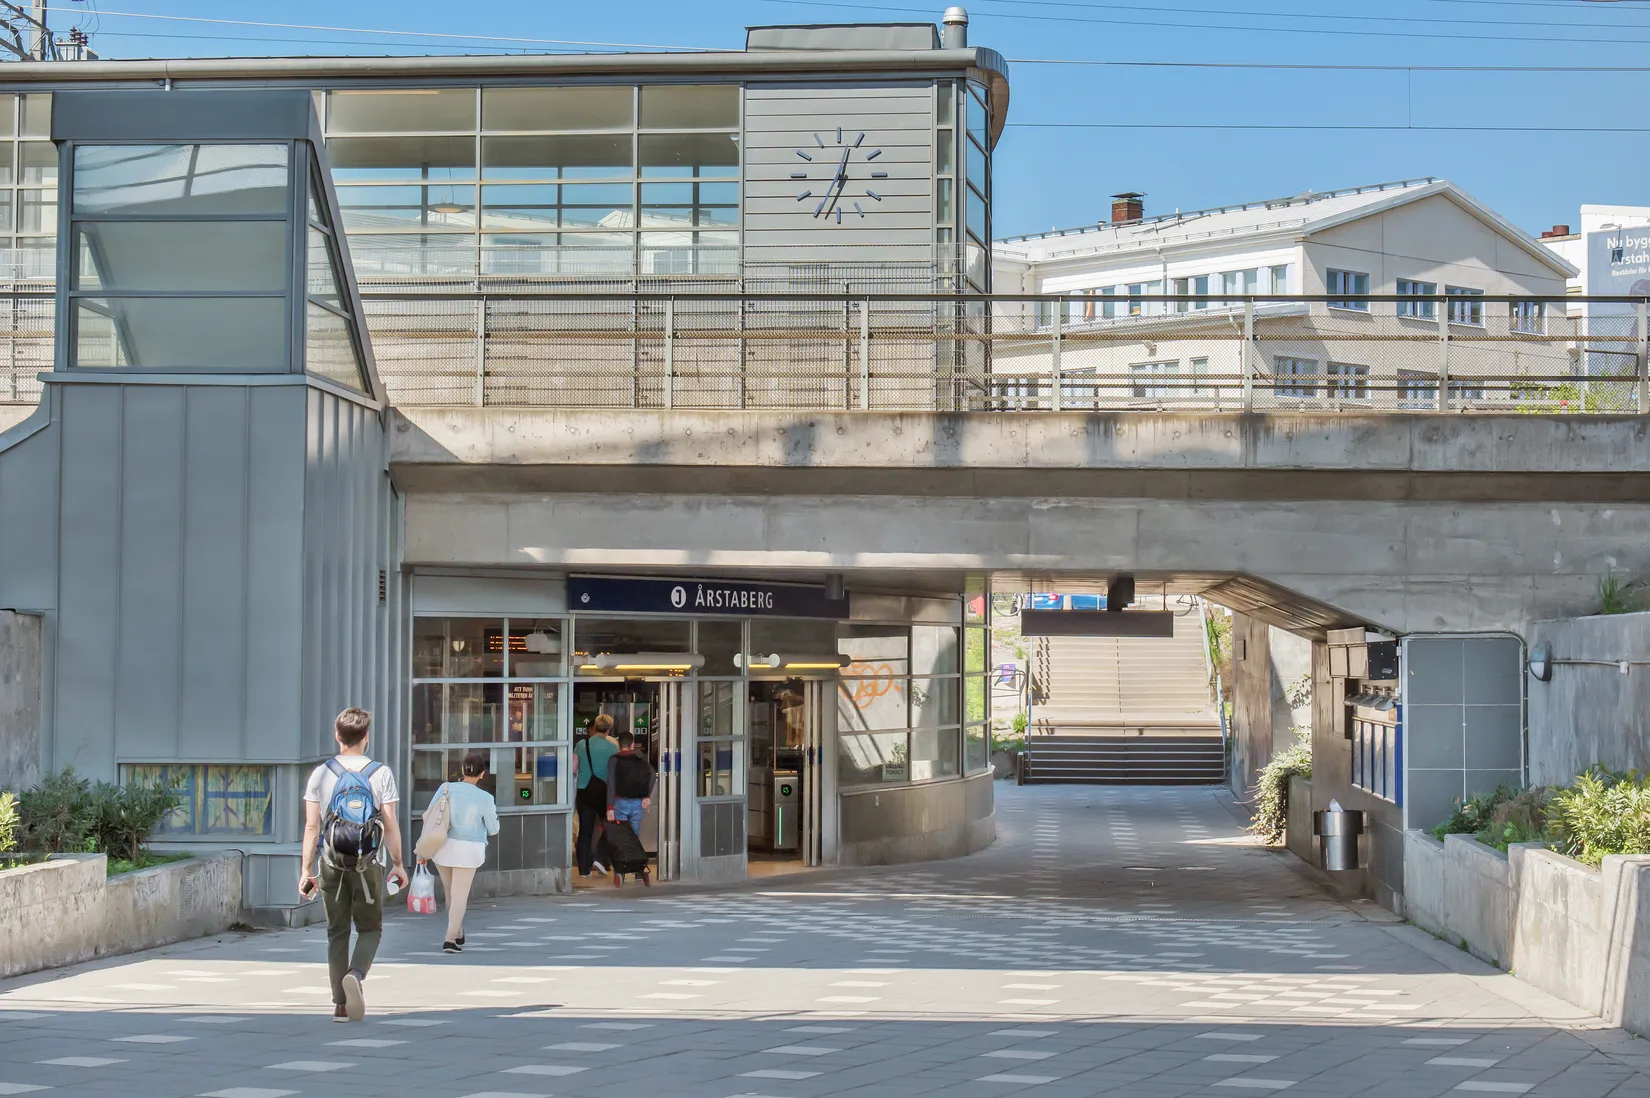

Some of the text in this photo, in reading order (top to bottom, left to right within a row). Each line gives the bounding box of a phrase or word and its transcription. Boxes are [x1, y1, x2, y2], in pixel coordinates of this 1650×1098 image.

[1607, 235, 1650, 250] Nu byg
[695, 584, 773, 609] ÅRSTABERG
